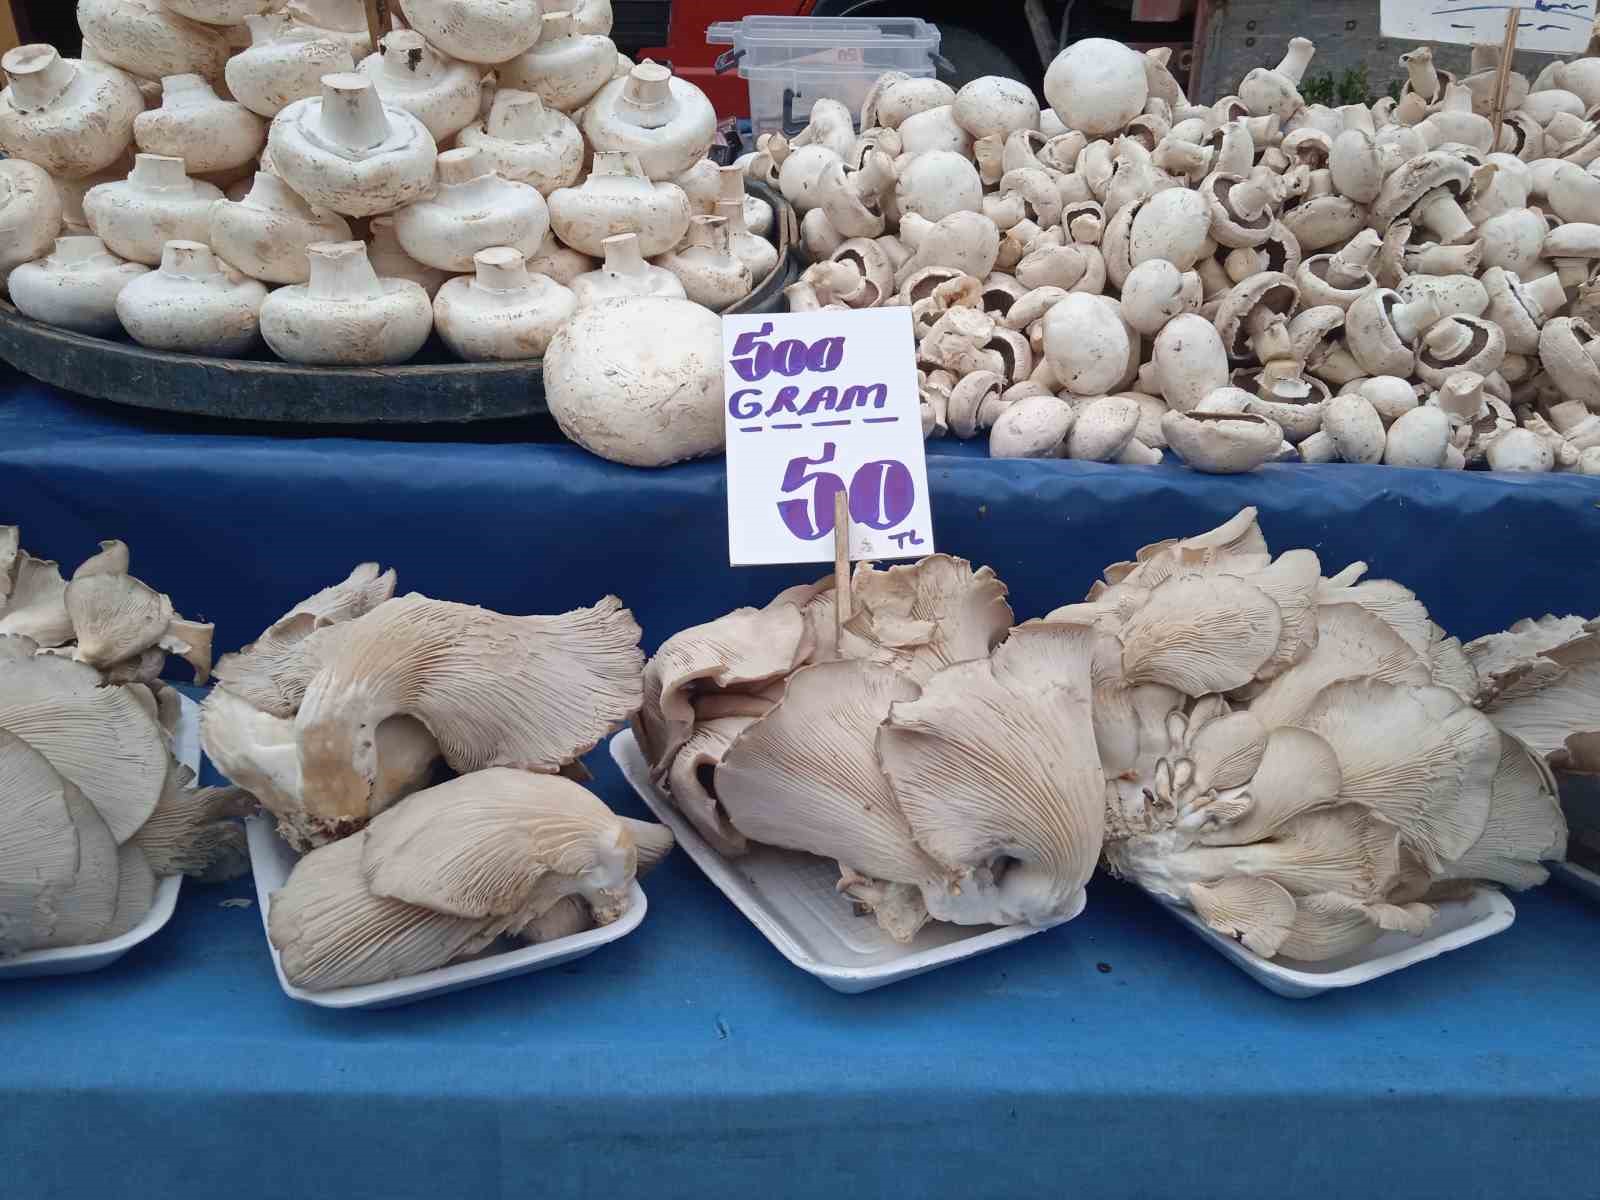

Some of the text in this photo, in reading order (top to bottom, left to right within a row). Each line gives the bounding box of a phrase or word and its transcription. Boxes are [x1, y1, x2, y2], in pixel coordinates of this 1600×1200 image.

[729, 322, 846, 382] 500
[728, 383, 888, 420] GRAM
[776, 442, 915, 541] 50
